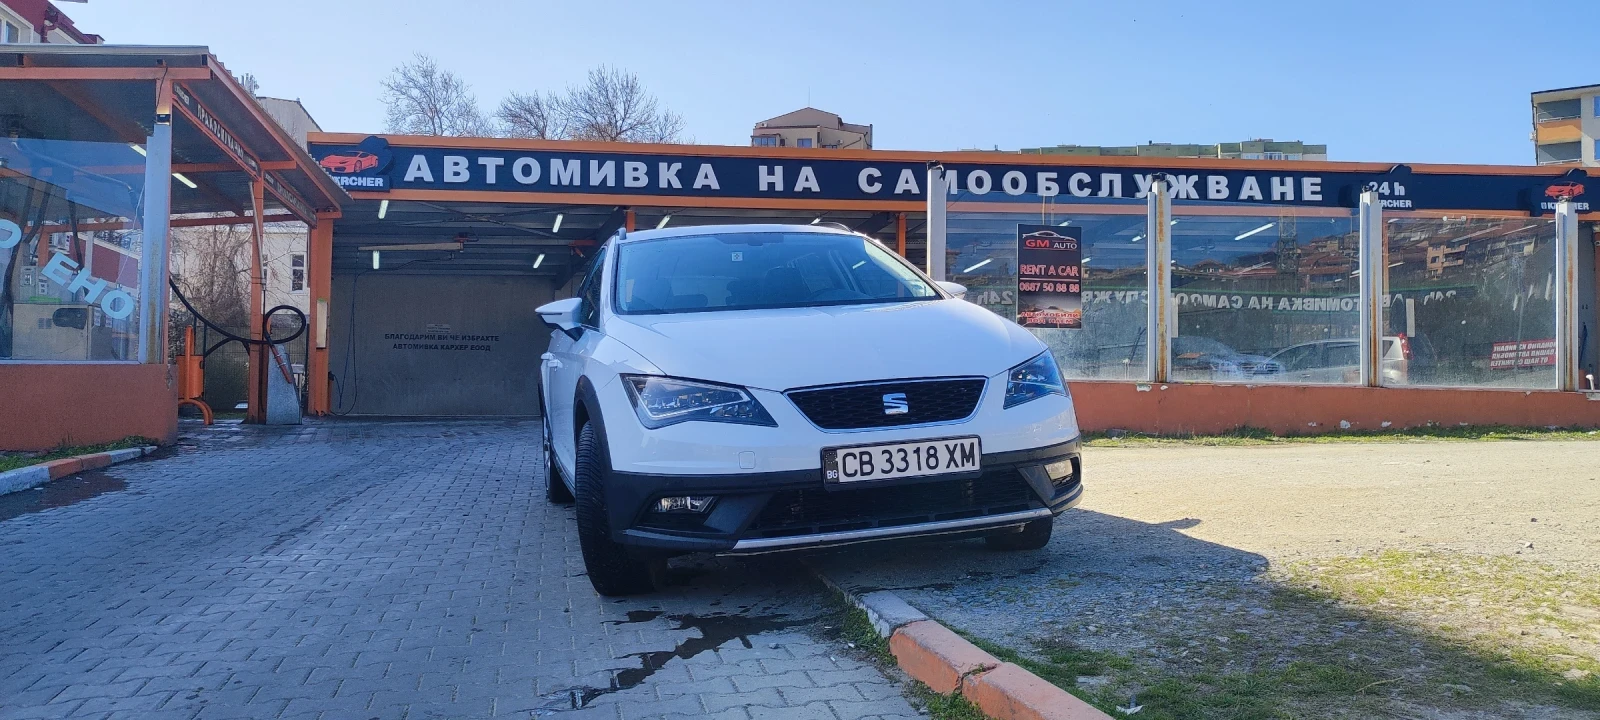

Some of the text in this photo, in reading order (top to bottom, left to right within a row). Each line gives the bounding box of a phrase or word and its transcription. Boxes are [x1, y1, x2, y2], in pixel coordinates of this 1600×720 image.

[404, 153, 721, 190] АВТОМИВКА
[758, 165, 821, 192] НА
[1368, 181, 1405, 196] 24 h
[1025, 239, 1078, 250] GM AUTO
[1019, 263, 1079, 277] RENT A CAR
[41, 251, 134, 320] ЕНО
[1042, 282, 1054, 292] 50
[384, 333, 436, 341] БЛАГОДАРИМ
[470, 344, 491, 352] ЕООД
[842, 442, 976, 478] CB 3318 XM
[826, 470, 838, 480] BG
